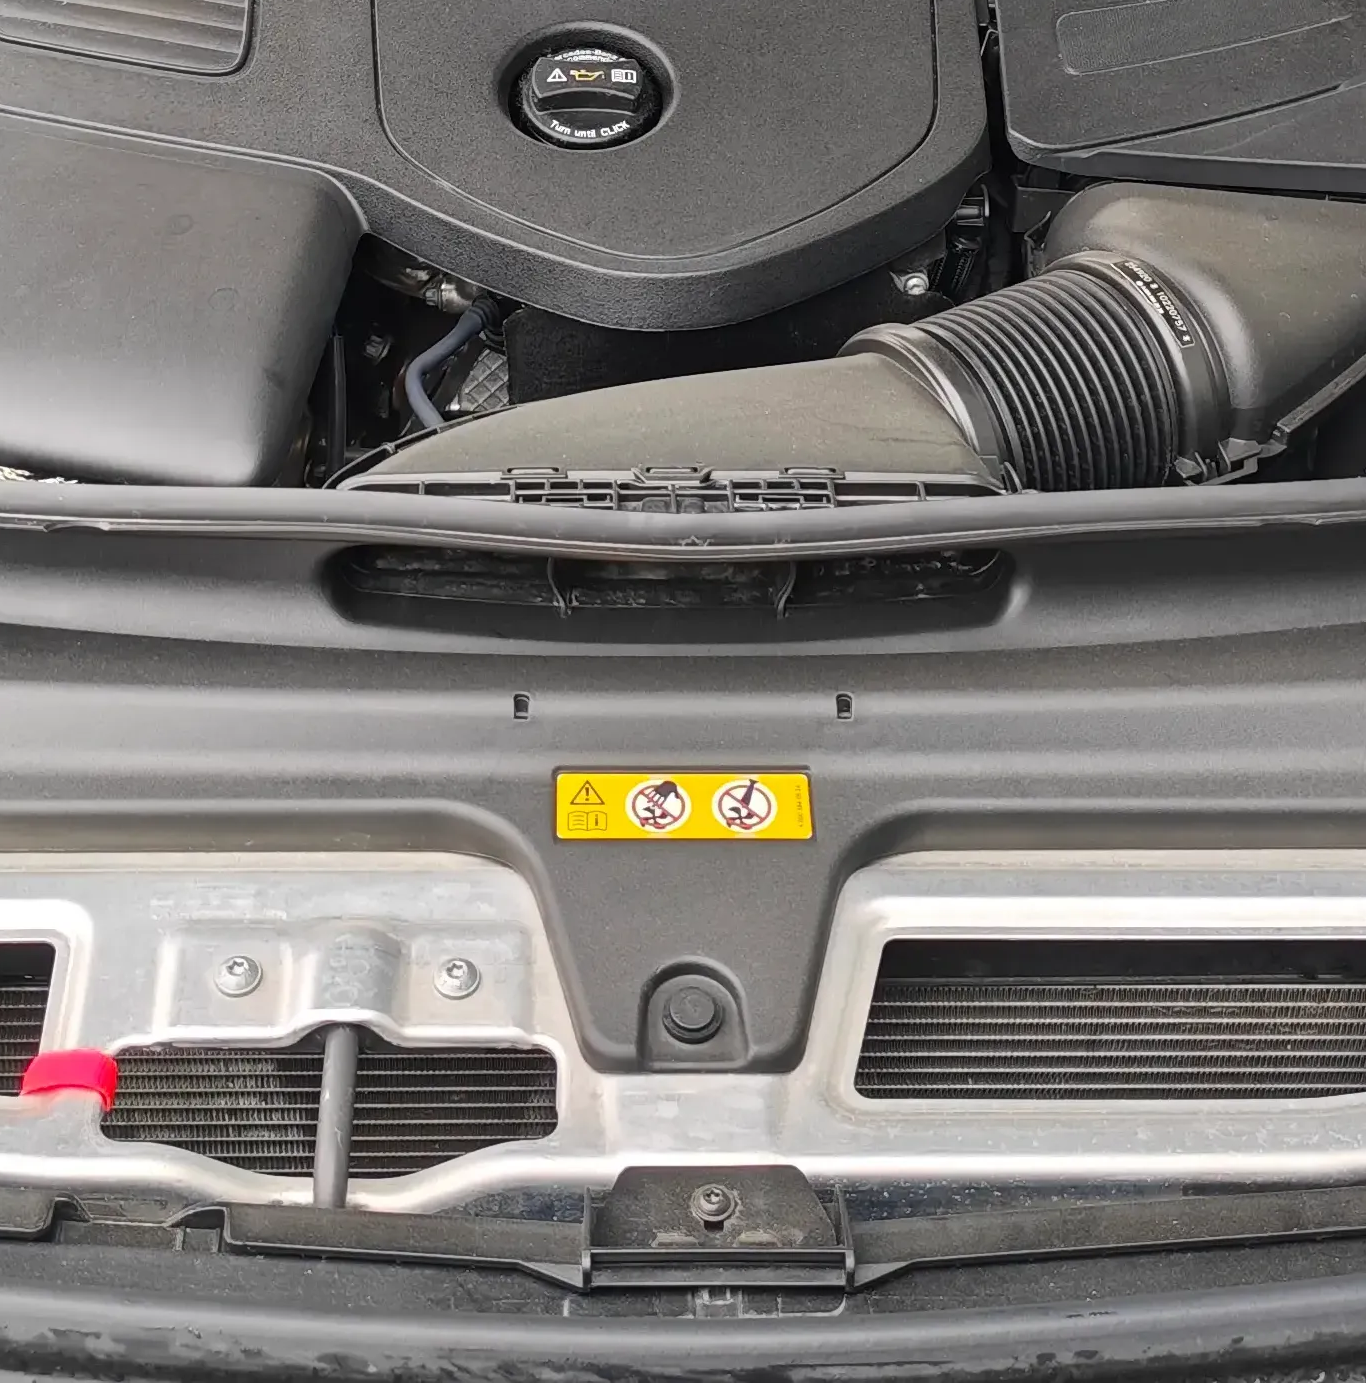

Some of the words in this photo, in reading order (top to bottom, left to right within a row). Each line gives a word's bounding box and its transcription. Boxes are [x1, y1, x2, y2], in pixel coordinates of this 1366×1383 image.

[550, 120, 571, 135] Turn
[574, 129, 596, 138] until
[600, 120, 631, 137] CLICK
